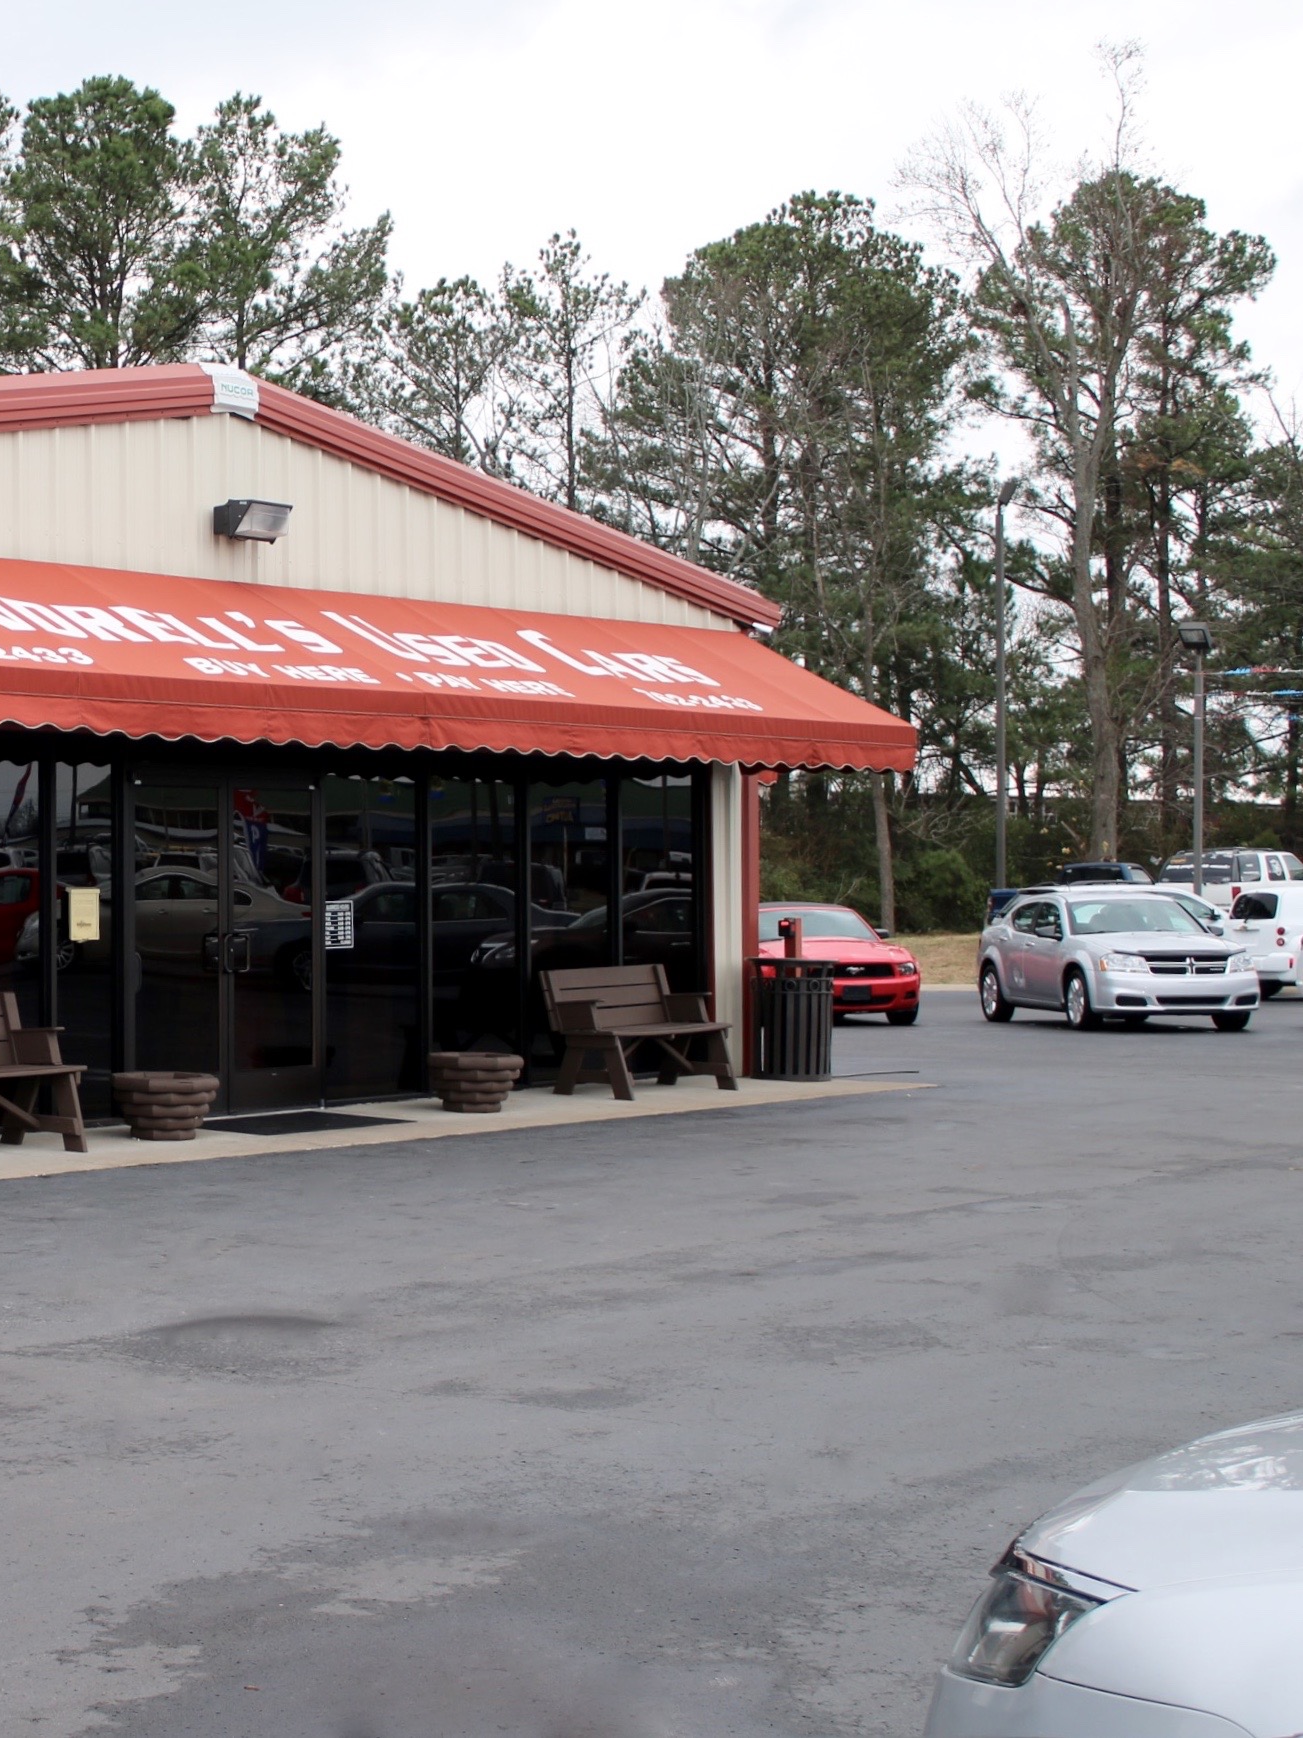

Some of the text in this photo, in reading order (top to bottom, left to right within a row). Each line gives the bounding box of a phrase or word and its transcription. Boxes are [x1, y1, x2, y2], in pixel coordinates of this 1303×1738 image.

[220, 383, 255, 396] NUCOR
[320, 610, 547, 673] USED
[516, 629, 722, 688] CARS
[182, 656, 577, 698] BUY HERE PAY HERE
